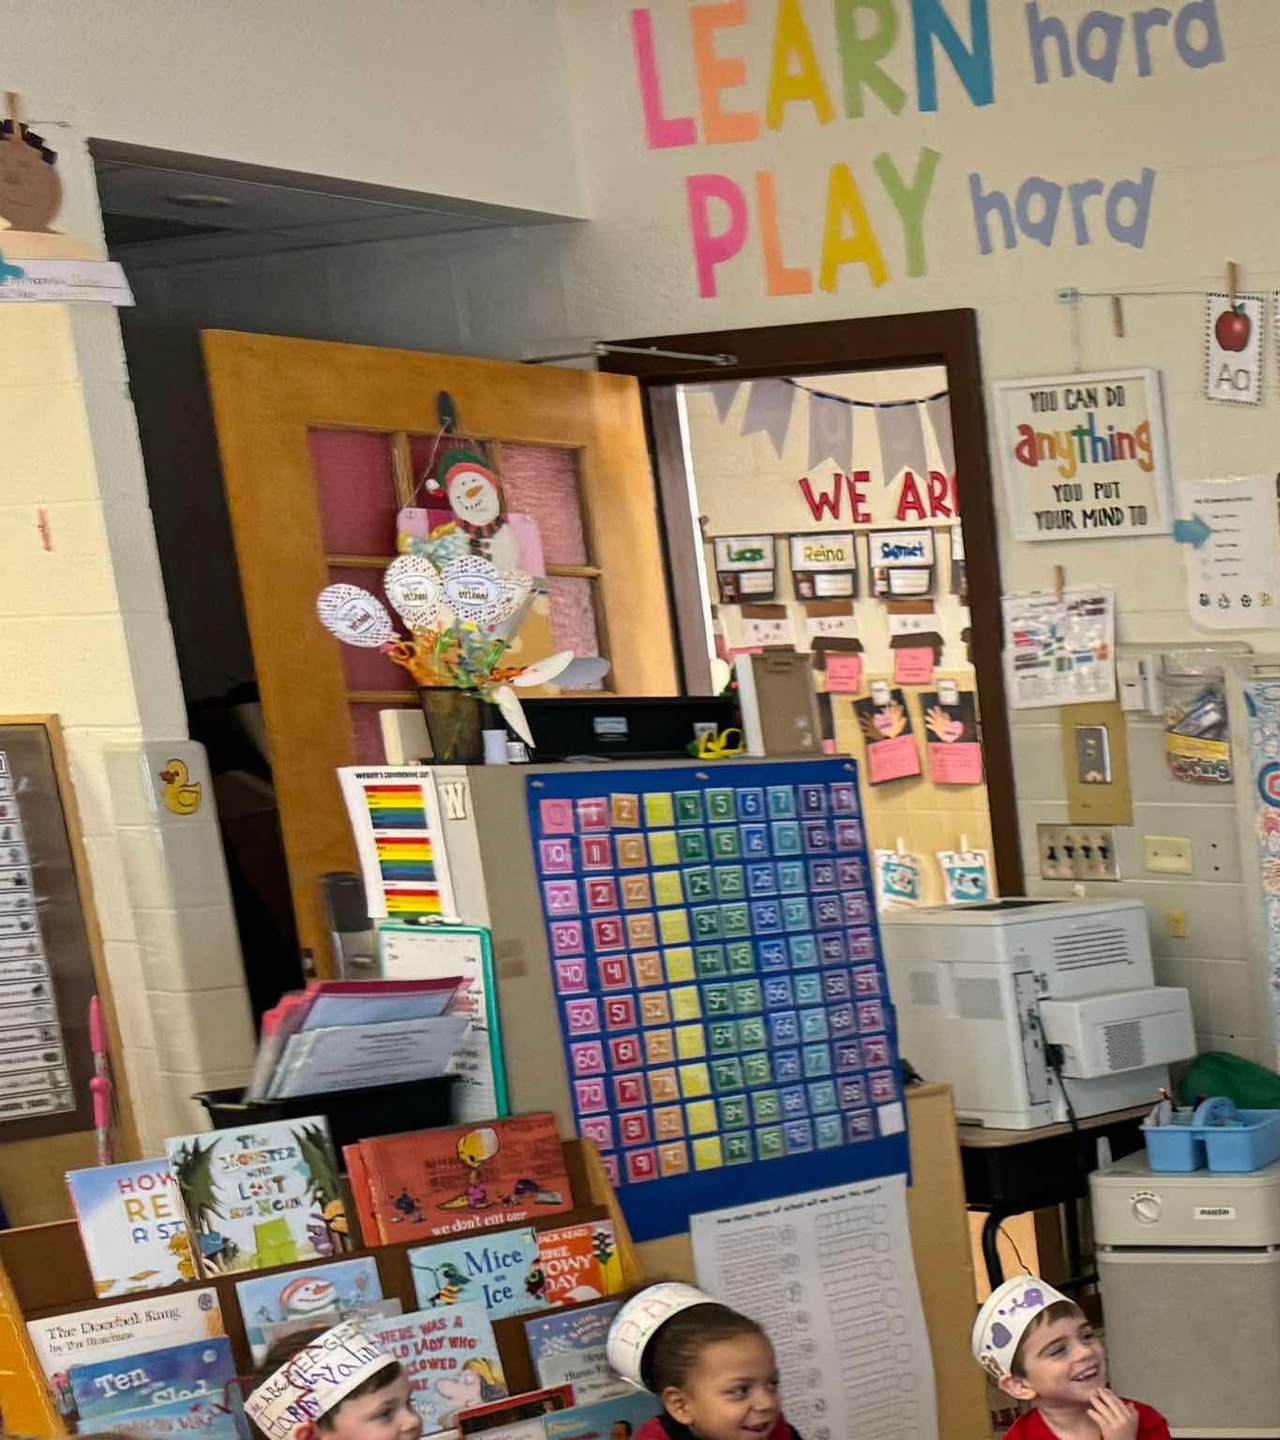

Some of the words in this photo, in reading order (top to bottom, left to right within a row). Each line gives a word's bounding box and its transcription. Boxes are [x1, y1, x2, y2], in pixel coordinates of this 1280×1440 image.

[631, 0, 995, 150] LEARN
[687, 146, 940, 298] PLAY
[969, 166, 1156, 254] hard
[1216, 363, 1251, 390] Aa
[1030, 391, 1058, 413] YOU
[1065, 387, 1098, 411] CAN
[1105, 385, 1127, 407] DO
[1015, 412, 1155, 479] anything
[799, 471, 872, 523] WE
[1053, 483, 1083, 502] YOU
[1095, 481, 1122, 499] PUT
[1035, 510, 1077, 531] YOUR
[1082, 506, 1124, 528] MIND
[1129, 505, 1148, 526] TO
[117, 1171, 176, 1194] HOW
[238, 1176, 287, 1200] LOST
[465, 1248, 524, 1277] Mice
[482, 1286, 514, 1309] Ice
[419, 1316, 448, 1336] WAS
[453, 1316, 464, 1329] A
[414, 1336, 444, 1357] LADY
[448, 1335, 478, 1350] WHO
[93, 1366, 151, 1399] Ten
